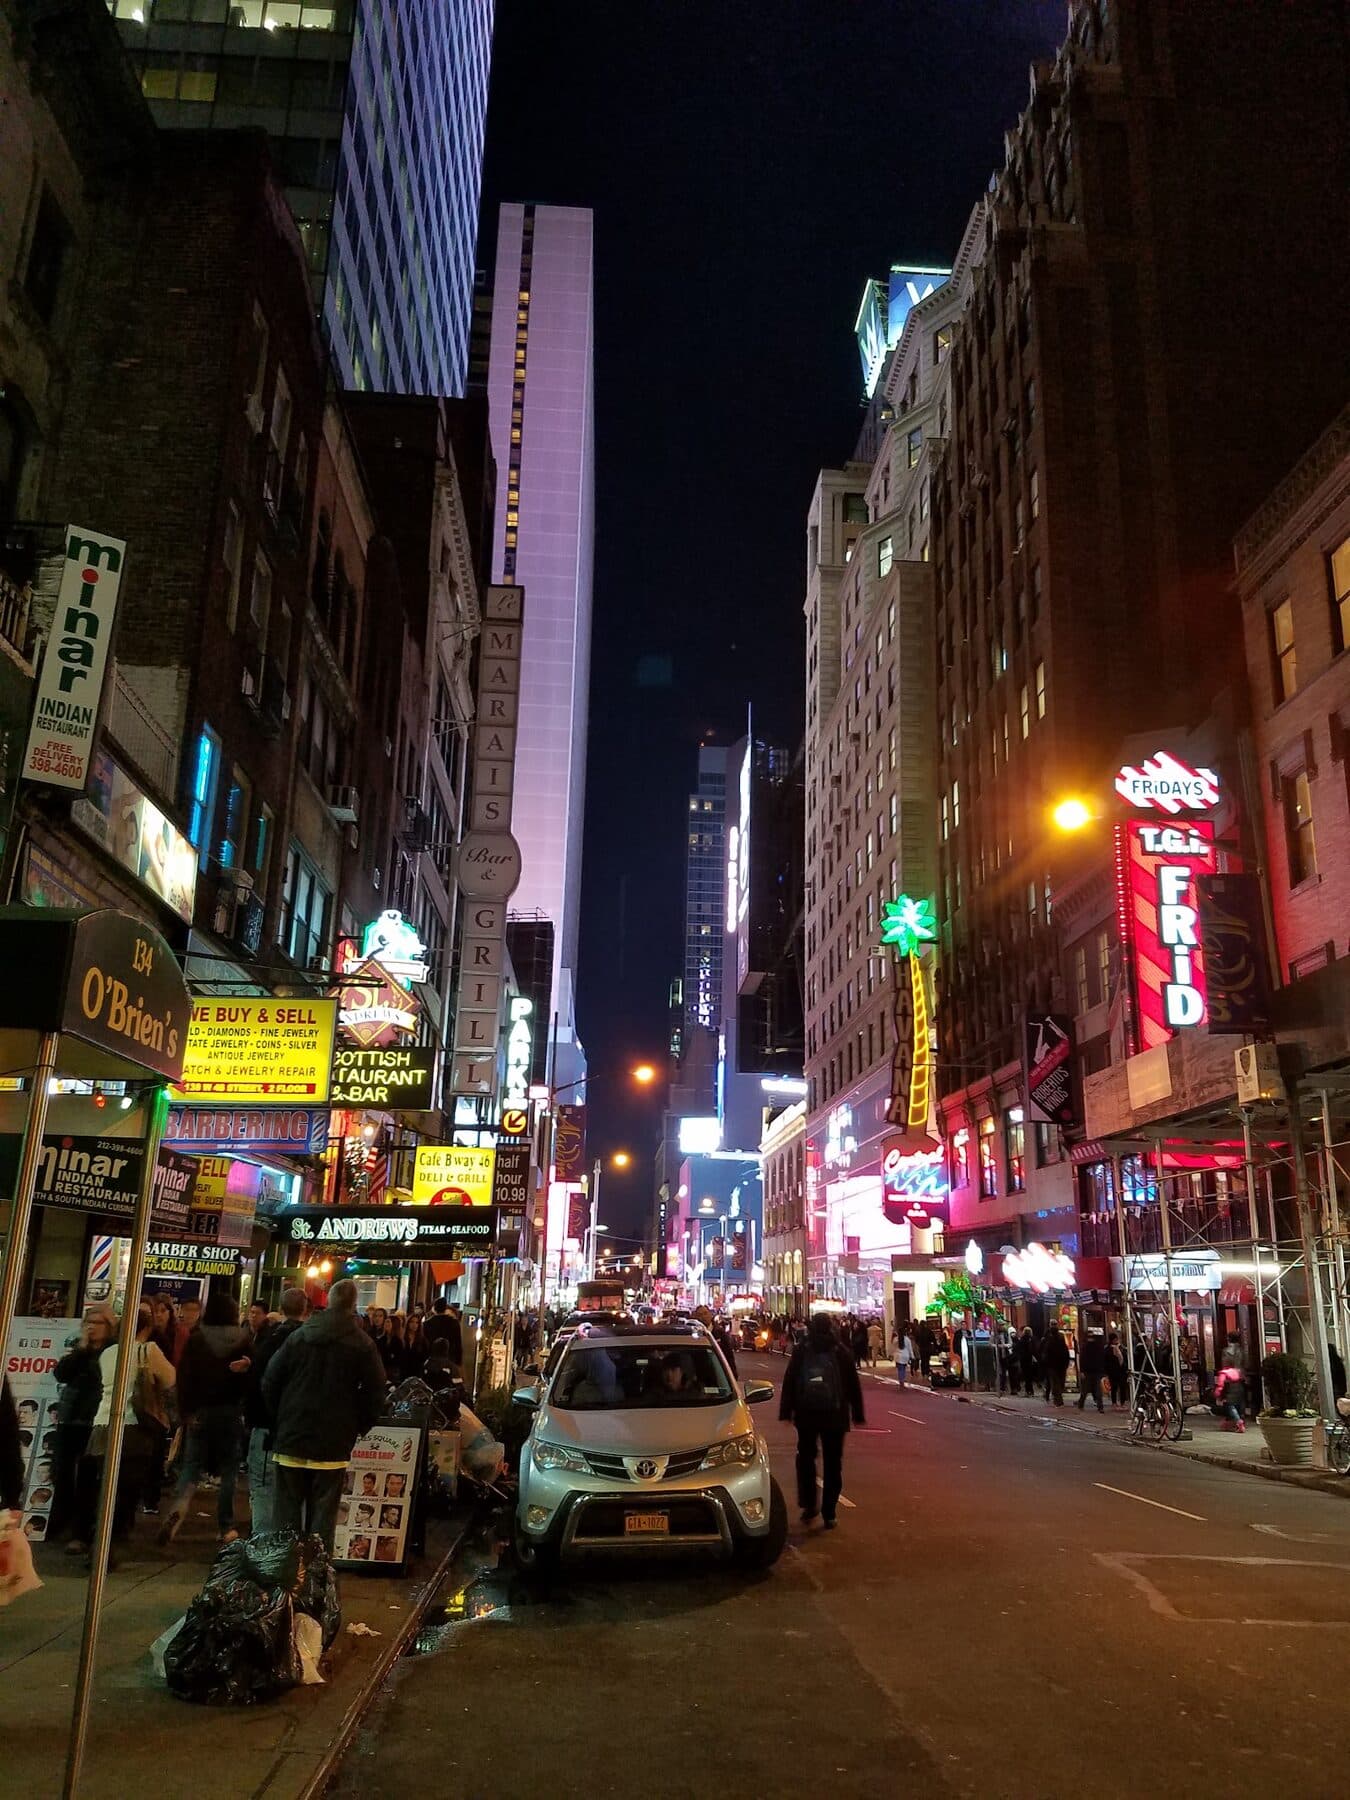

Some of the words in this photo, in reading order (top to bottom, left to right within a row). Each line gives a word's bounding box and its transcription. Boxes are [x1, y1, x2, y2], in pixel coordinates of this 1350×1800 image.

[57, 534, 121, 693] minar
[39, 697, 93, 725] INDIAN
[36, 716, 90, 739] RESTAURANT
[485, 631, 513, 820] MARAIS
[33, 747, 85, 765] DELIVERY
[46, 741, 73, 754] FREE
[29, 756, 83, 779] 398-4600
[465, 847, 513, 864] Bar
[480, 868, 497, 880] &
[132, 938, 154, 976] 134
[466, 909, 495, 1084] GRILL
[82, 967, 178, 1058] O'Brien's
[215, 1007, 252, 1022] BUY
[257, 1008, 269, 1024] &
[275, 1009, 317, 1024] SELL
[207, 1027, 251, 1037] DIAMONDS
[260, 1028, 279, 1037] FINE
[281, 1029, 319, 1038] JEWELRY
[210, 1039, 249, 1049] JEWELRY
[255, 1040, 282, 1049] COINS
[288, 1041, 317, 1050] SILVER
[207, 1052, 244, 1060] ANTIQUE
[247, 1052, 285, 1061] JEWELRY
[184, 1065, 211, 1075] ATCH
[215, 1066, 222, 1075] &
[226, 1066, 274, 1076] JEWELRY
[279, 1066, 316, 1077] REPAIR
[349, 1086, 388, 1102] BAR
[165, 1110, 309, 1141] BARBERING
[200, 1158, 227, 1178] ELL
[497, 1155, 520, 1168] half
[57, 1170, 105, 1187] INDIAN
[419, 1172, 443, 1182] DELI
[457, 1173, 488, 1183] GRILL
[496, 1170, 523, 1185] hour
[55, 1182, 138, 1204] RESTAURANT
[495, 1187, 526, 1201] 10.98
[55, 1194, 81, 1204] SOUTH
[82, 1198, 107, 1209] INDIAN
[107, 1202, 136, 1214] CUISINE
[291, 1217, 314, 1240] St.
[316, 1217, 418, 1240] ANDREWS
[419, 1225, 446, 1234] STEAK
[451, 1225, 490, 1234] SEAFOOD
[144, 1241, 198, 1258] BARBER
[201, 1246, 239, 1261] SHOP
[161, 1258, 185, 1272] GOLD
[186, 1260, 193, 1272] &
[195, 1262, 236, 1276] DIAMOND
